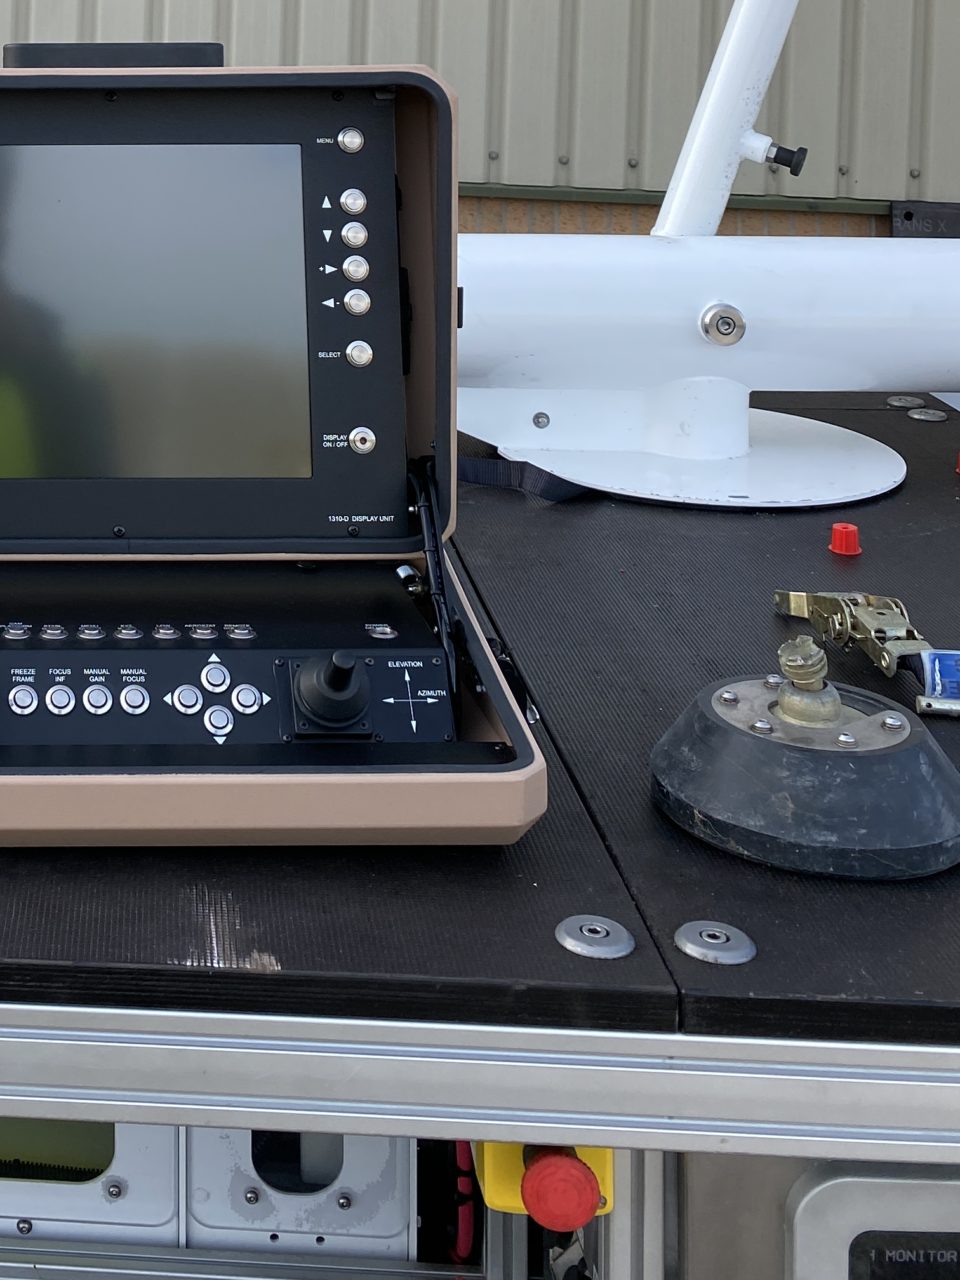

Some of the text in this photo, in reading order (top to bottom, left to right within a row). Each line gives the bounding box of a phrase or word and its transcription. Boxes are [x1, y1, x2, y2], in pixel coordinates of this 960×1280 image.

[387, 660, 423, 668] ELEVATION
[417, 689, 447, 697] AZIMUTH
[885, 1248, 958, 1263] MONITOR
